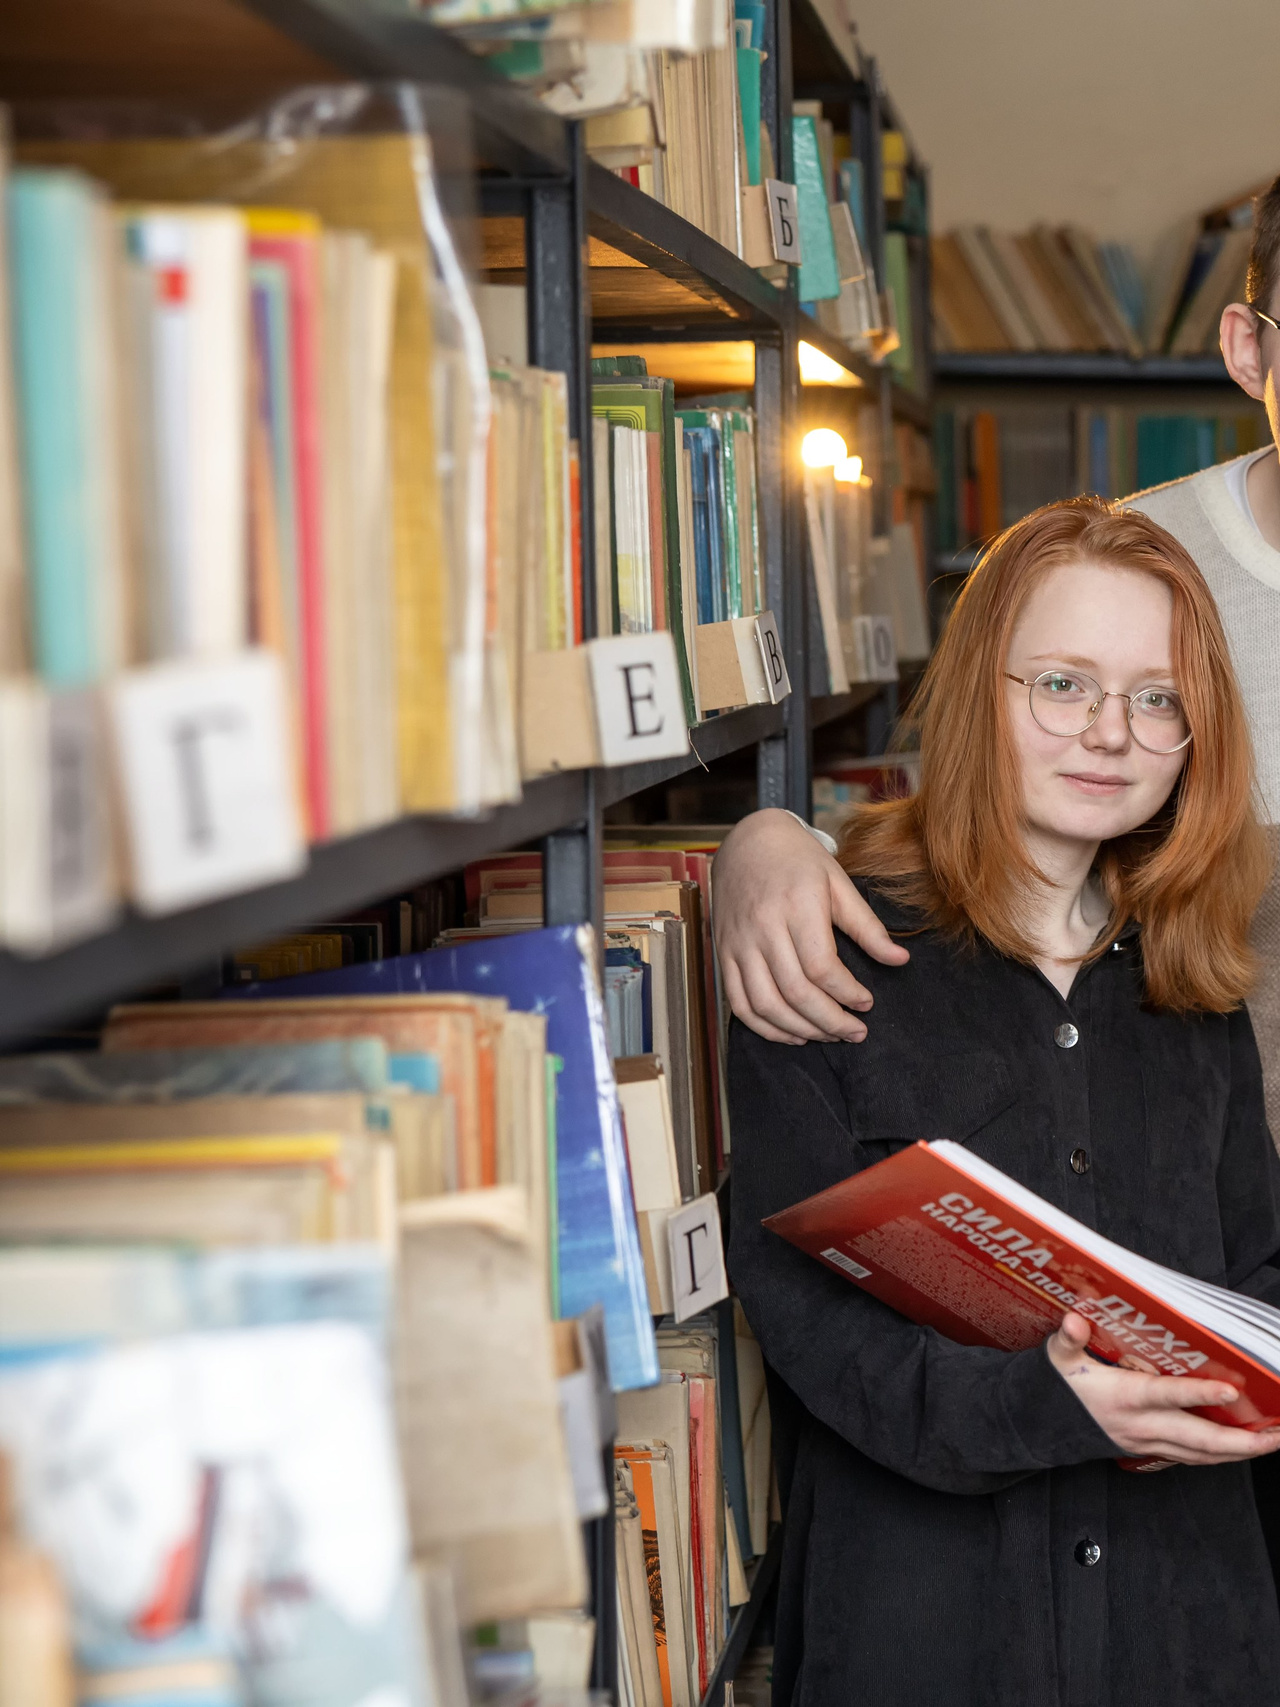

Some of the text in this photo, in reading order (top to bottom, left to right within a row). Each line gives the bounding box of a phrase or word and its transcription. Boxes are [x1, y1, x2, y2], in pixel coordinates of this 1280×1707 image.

[776, 196, 794, 247] Б
[764, 630, 783, 685] В
[617, 662, 664, 738] Е
[166, 703, 243, 857] Г
[683, 1222, 708, 1297] Г
[920, 1202, 1188, 1376] НАРОДА-ПОБЕДИТЕЛЯ
[938, 1192, 1210, 1371] СИЛА ДУХА
